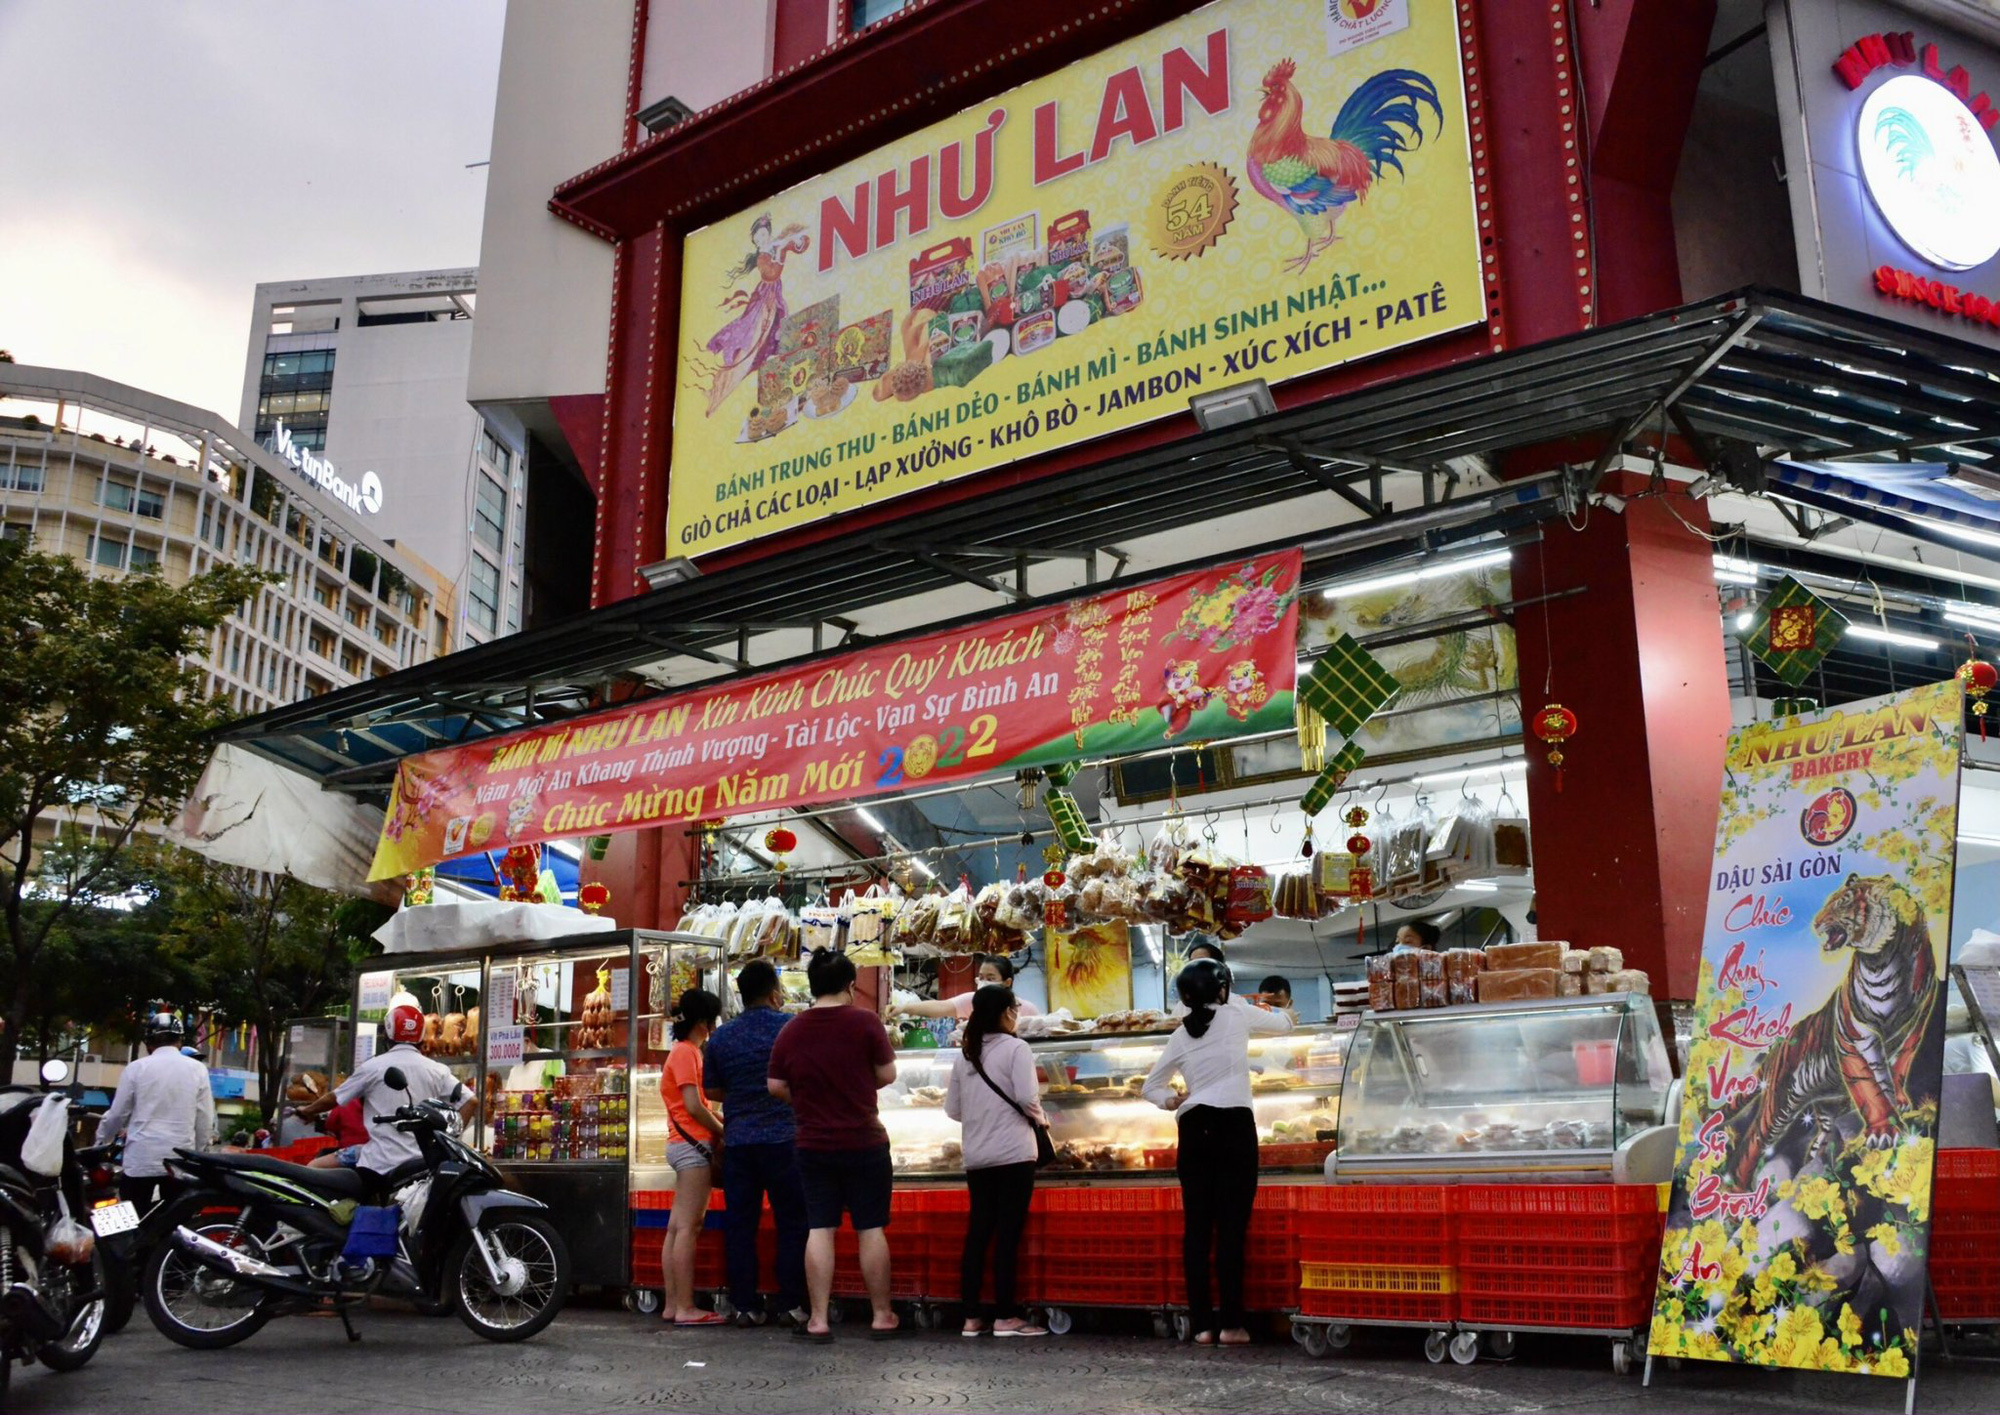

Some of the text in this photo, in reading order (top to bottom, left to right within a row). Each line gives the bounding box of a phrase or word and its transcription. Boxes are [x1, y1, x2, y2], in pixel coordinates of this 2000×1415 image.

[1923, 42, 2000, 130] LAN
[817, 27, 1231, 273] NHƯ LAN
[1166, 193, 1214, 232] 54
[1173, 223, 1205, 243] NĂM
[1873, 265, 1963, 314] SINCE
[681, 518, 711, 545] GIÒ
[715, 497, 751, 534] CHẢ
[756, 491, 792, 520] CÁC
[796, 477, 839, 508] LOẠI
[855, 462, 892, 492] LẠP
[895, 439, 972, 477] XƯỞNG
[990, 410, 1040, 449] KHÔ
[1046, 398, 1078, 432] BÒ
[1097, 363, 1201, 416] JAMBON
[1223, 339, 1277, 377] XÚC
[1284, 317, 1351, 357] XÍCH
[1376, 281, 1448, 330] PATÊ
[716, 468, 764, 502] BÁNH
[769, 447, 832, 482] TRUNG
[837, 432, 875, 463] THU
[892, 412, 950, 445] BÁNH
[956, 391, 999, 424] DẺO
[1016, 371, 1081, 405] BÁNH
[1087, 347, 1117, 382] MÌ
[1137, 329, 1206, 365] BÁNH
[1214, 300, 1278, 341] SINH
[1287, 273, 1386, 317] NHẬT...
[276, 420, 362, 515] VietinBank
[487, 625, 1045, 774] BÁNH MÌ NHƯ LAN Xin Kính Chúc Quý Khách
[473, 780, 509, 805] Năm
[512, 771, 547, 797] Mới
[547, 770, 573, 792] An
[576, 757, 638, 787] Khang
[640, 742, 695, 776] Thịnh
[701, 731, 770, 764] Vượng
[785, 716, 820, 749] Tài
[823, 712, 861, 747] Lộc
[876, 703, 916, 735] Vạn
[922, 692, 958, 725] Sự
[961, 676, 1018, 712] Bình
[1024, 671, 1059, 699] An
[1744, 702, 1935, 769] NHƯ LAN
[542, 795, 613, 834] Chúc
[616, 783, 705, 824] Mừng
[715, 768, 789, 809] Năm
[799, 750, 867, 796] Mới
[1791, 747, 1876, 782] BAKERY
[1716, 852, 1842, 894] DẬU SÀI GÒN
[1723, 893, 1794, 934] Chúc
[1714, 941, 1779, 1001] Quý
[1707, 1002, 1793, 1049] Khách
[1707, 1048, 1758, 1103] Vạn
[1698, 1111, 1727, 1163] Sự
[1691, 1170, 1770, 1221] Bình
[1671, 1240, 1721, 1287] An
